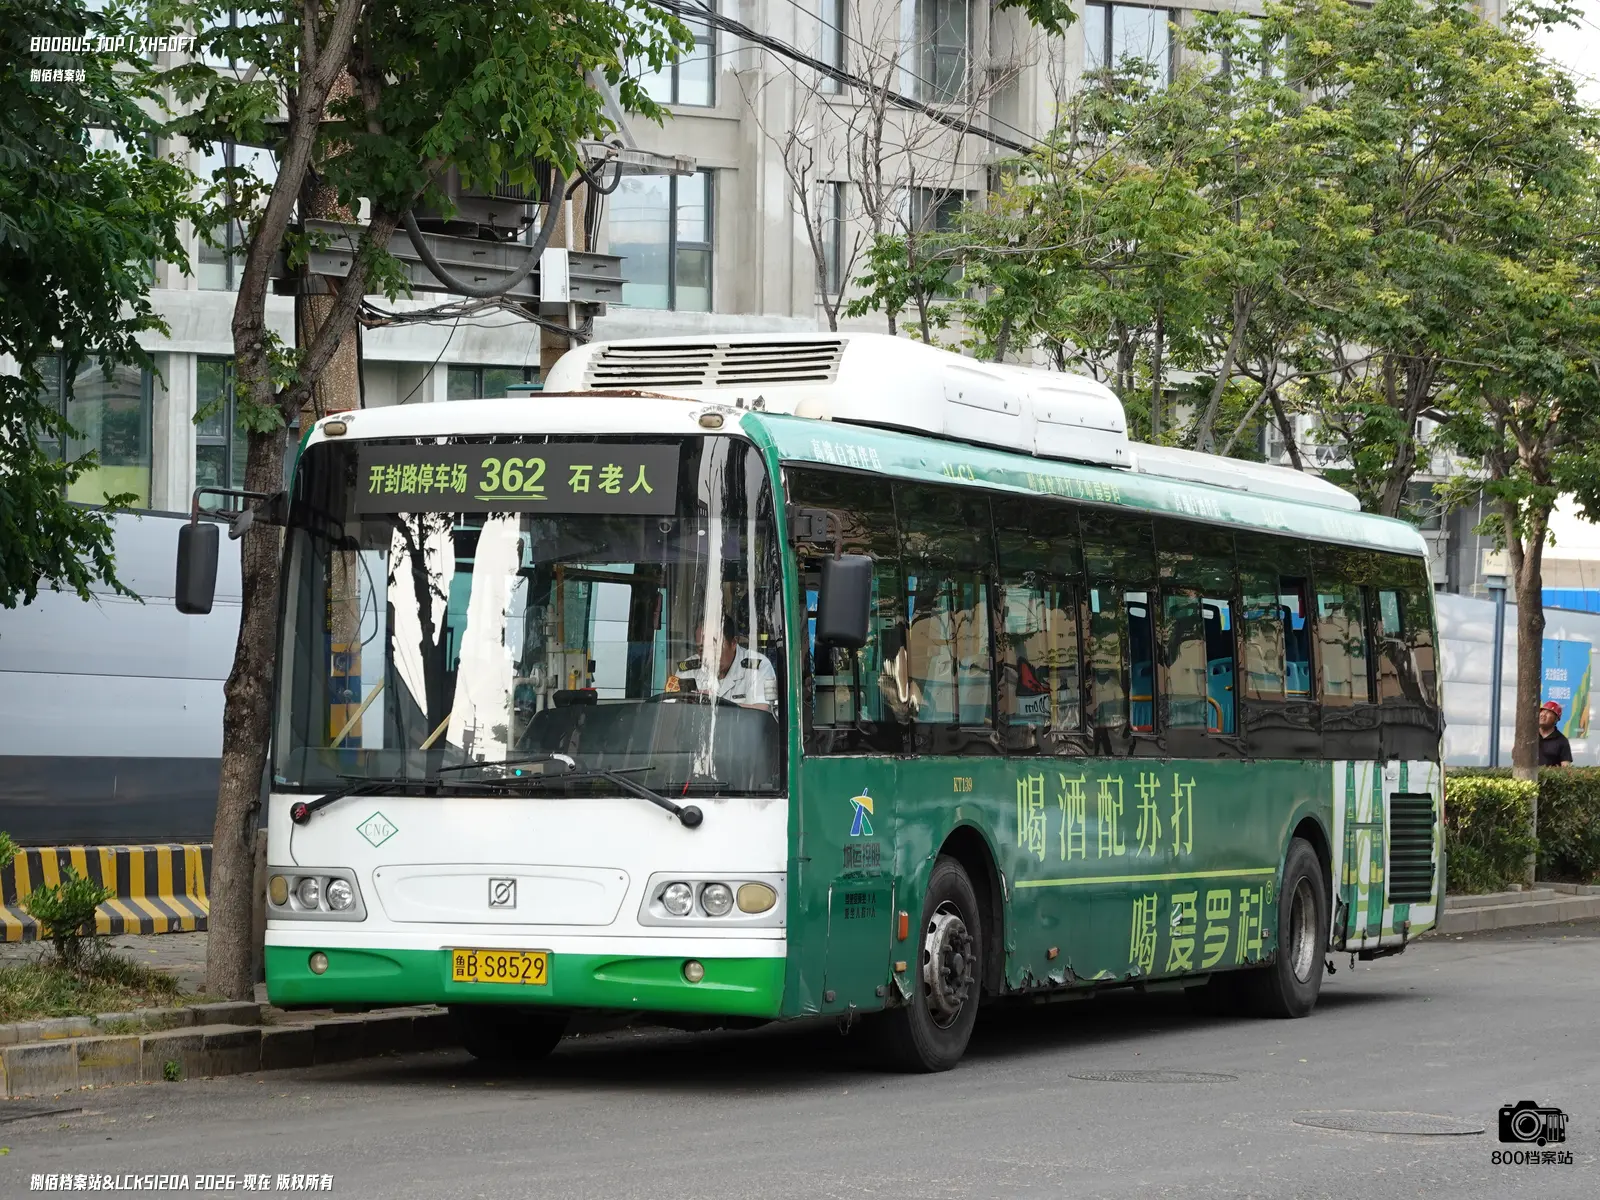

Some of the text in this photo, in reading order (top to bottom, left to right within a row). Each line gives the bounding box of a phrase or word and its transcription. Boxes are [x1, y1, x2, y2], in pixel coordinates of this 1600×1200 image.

[368, 457, 654, 494] 开封路停车场 362 石老人
[364, 823, 391, 838] CNG
[1016, 772, 1197, 862] 喝酒配苏打
[1128, 886, 1264, 976] 喝爱罗科
